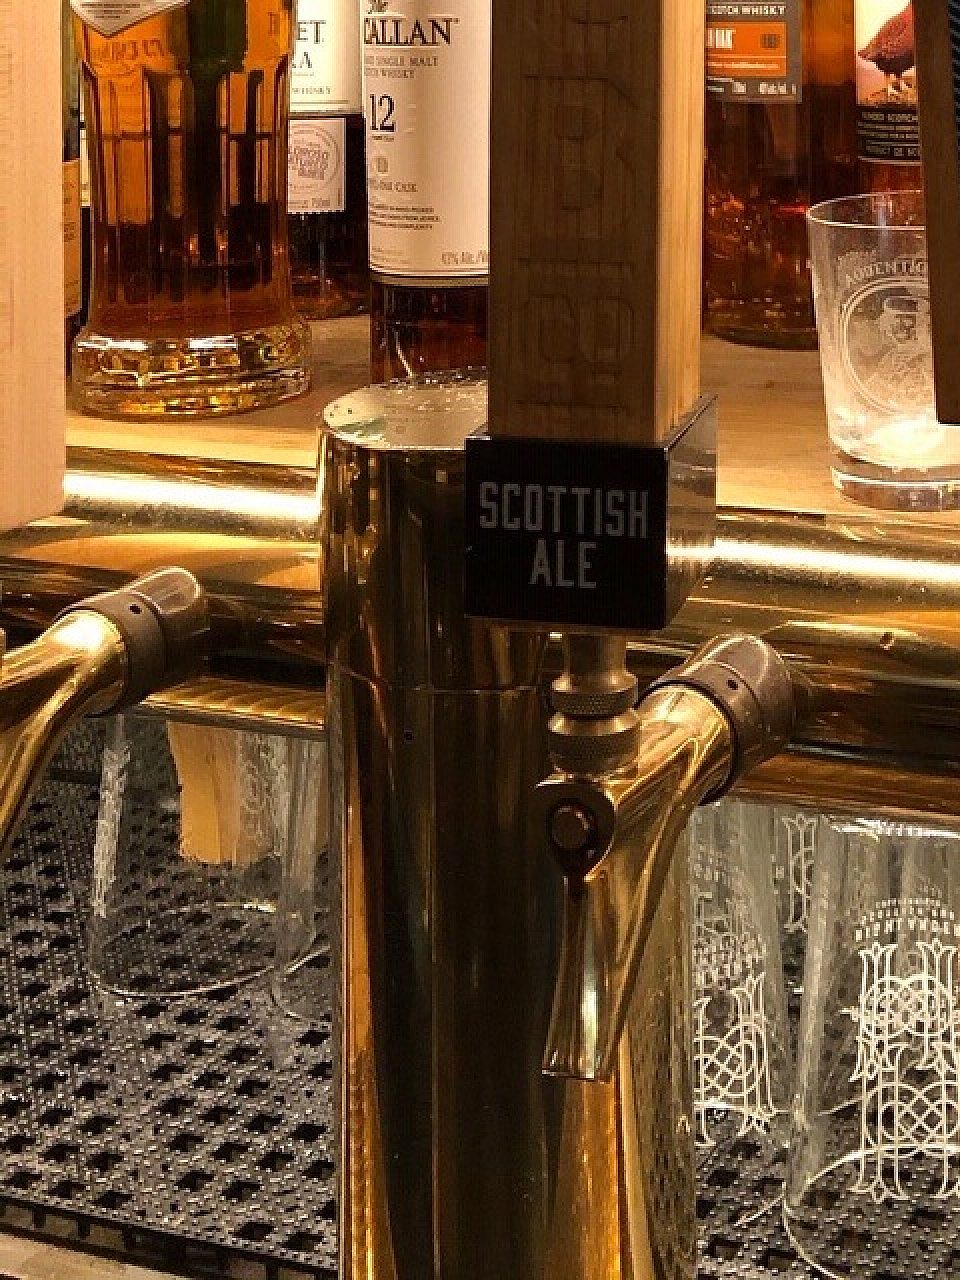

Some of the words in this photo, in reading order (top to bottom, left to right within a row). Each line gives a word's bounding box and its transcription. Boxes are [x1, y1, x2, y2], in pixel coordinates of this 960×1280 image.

[369, 93, 396, 133] 12
[479, 480, 650, 539] SCOTTISH
[528, 537, 598, 589] ALE
